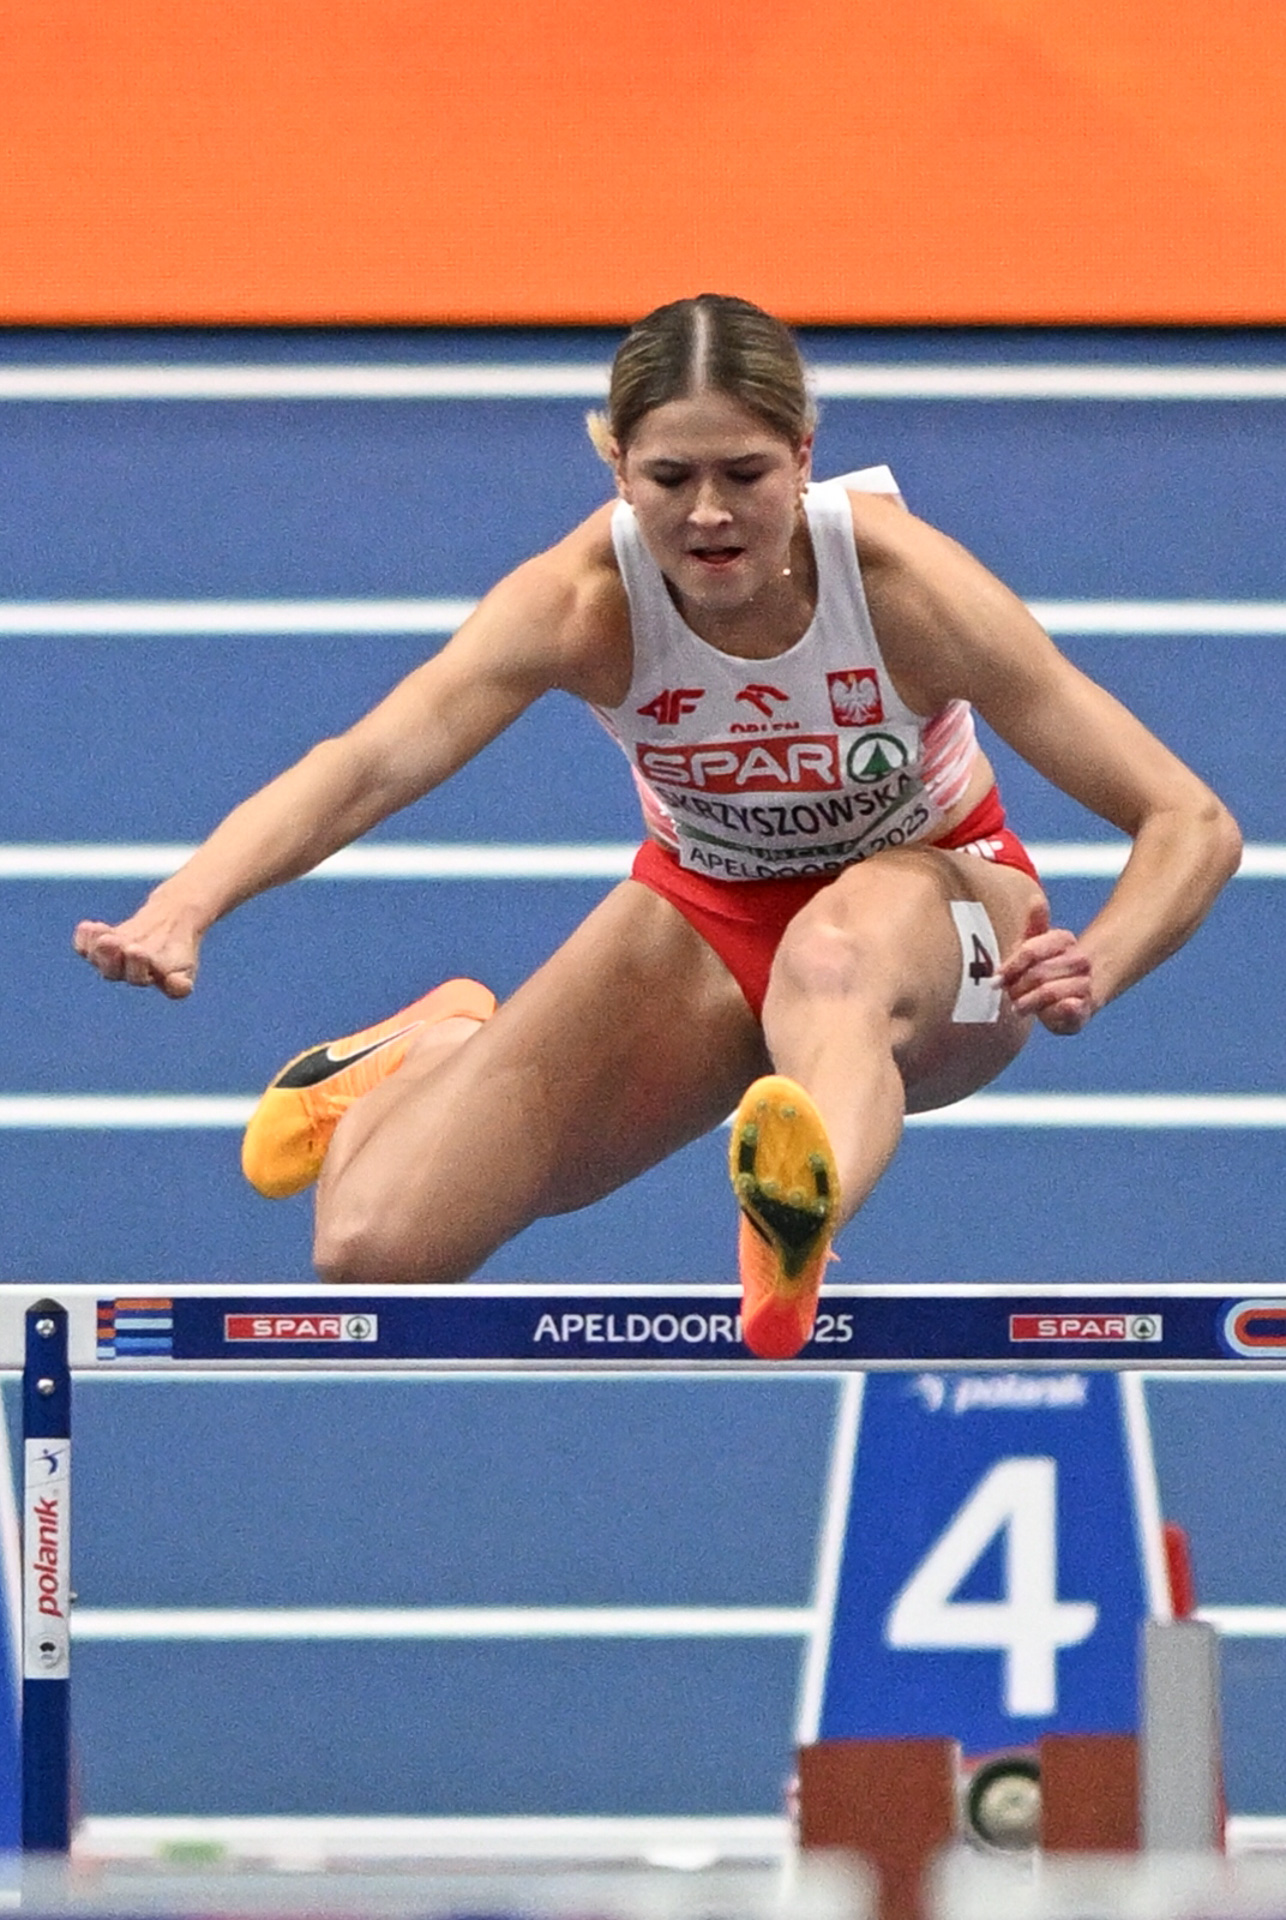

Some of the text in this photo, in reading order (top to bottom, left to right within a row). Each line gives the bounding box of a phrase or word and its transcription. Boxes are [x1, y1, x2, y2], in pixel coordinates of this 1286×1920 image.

[642, 742, 837, 787] SPAR
[870, 802, 930, 852] 2025
[252, 1319, 340, 1336] SPAR
[1037, 1319, 1125, 1336] SPAR
[33, 1495, 64, 1619] polanik
[885, 1455, 1098, 1718] 4
